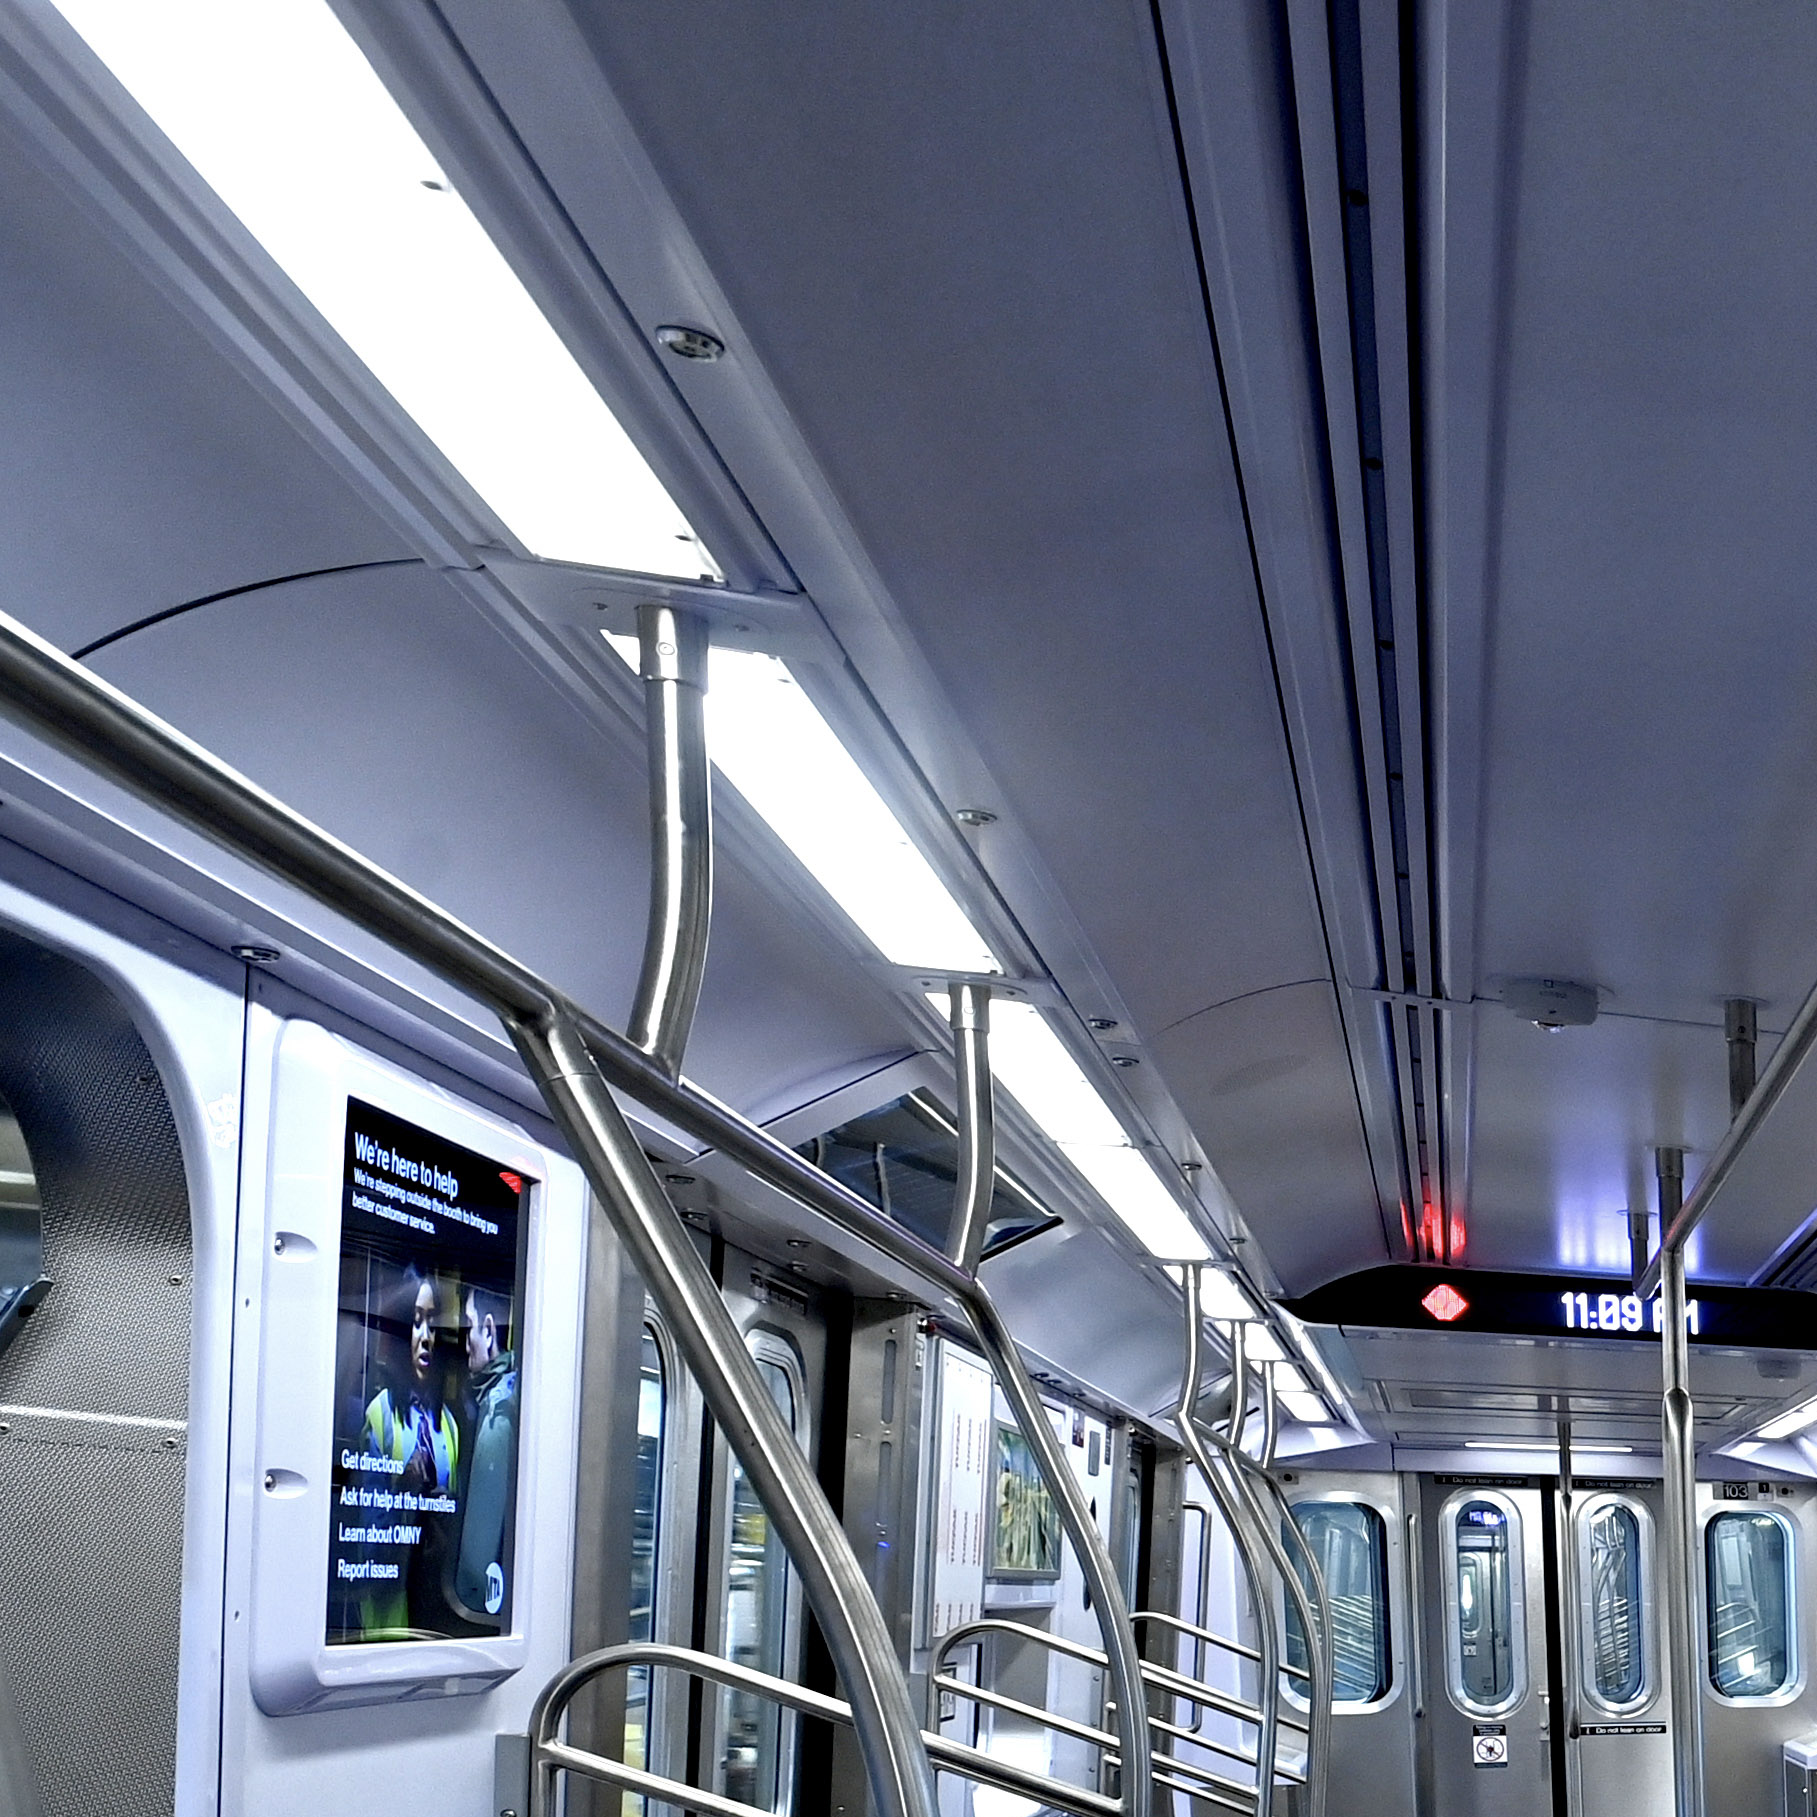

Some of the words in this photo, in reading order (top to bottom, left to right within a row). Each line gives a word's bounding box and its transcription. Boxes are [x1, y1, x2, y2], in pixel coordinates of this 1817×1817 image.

[354, 1131, 390, 1170] We're
[391, 1147, 418, 1182] here
[420, 1161, 432, 1187] to
[434, 1165, 458, 1202] help
[352, 1191, 375, 1213] better
[375, 1203, 410, 1225] customer
[410, 1216, 436, 1235] service.
[375, 1178, 406, 1204] stepping
[406, 1191, 432, 1210] outside
[432, 1198, 443, 1214] the
[444, 1202, 462, 1222] booth
[463, 1209, 469, 1224] to
[470, 1211, 486, 1233] bring
[486, 1222, 498, 1235] you
[1561, 1292, 1643, 1332] 11:09
[342, 1449, 359, 1470] Get
[360, 1452, 404, 1475] directions
[340, 1486, 359, 1506] Ask
[359, 1487, 373, 1507] for
[373, 1488, 394, 1512] help
[394, 1492, 404, 1510] at
[404, 1491, 418, 1511] the
[418, 1494, 456, 1513] turnstiles
[1724, 1484, 1748, 1498] 103
[339, 1522, 366, 1543] Learn
[367, 1524, 393, 1543] about
[394, 1525, 422, 1545] OMNY
[338, 1559, 369, 1582] Report
[370, 1559, 399, 1579] issues
